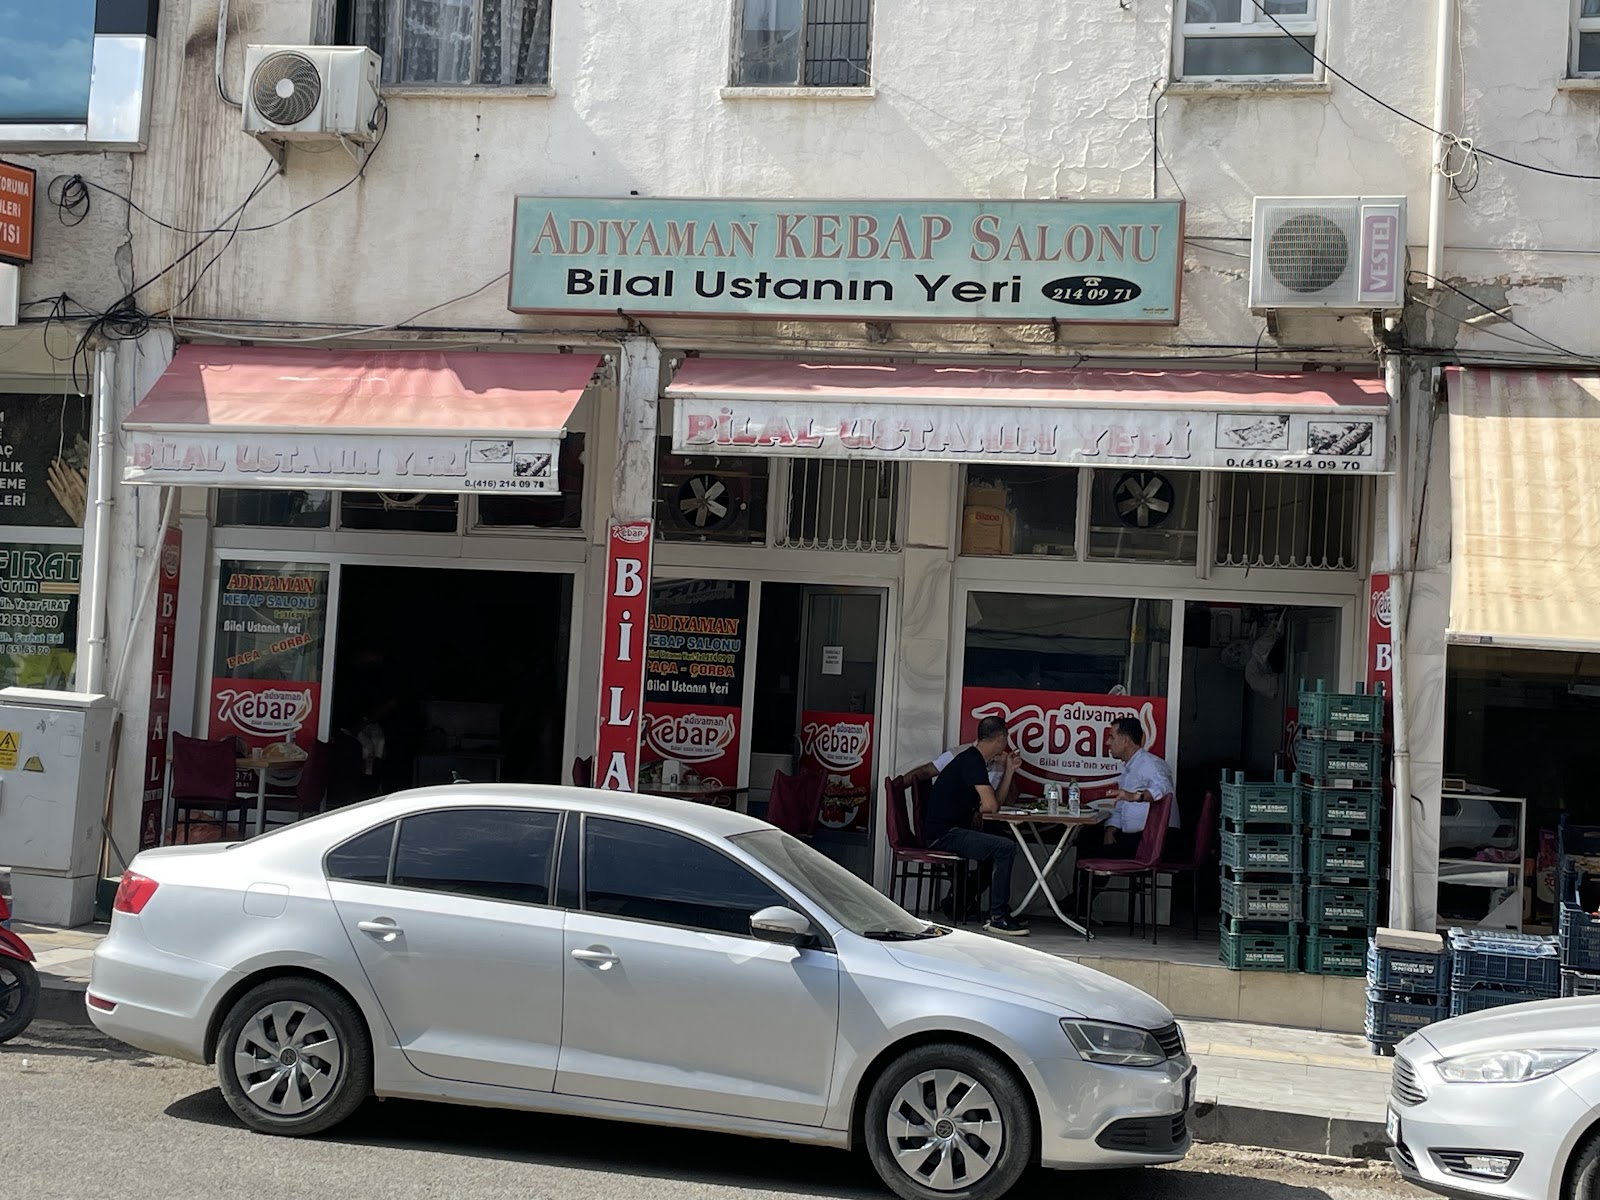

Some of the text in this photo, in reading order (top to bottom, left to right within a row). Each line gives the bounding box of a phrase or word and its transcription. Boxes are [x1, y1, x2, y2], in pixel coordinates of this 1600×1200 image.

[530, 211, 1162, 264] ADIYAMAN KEBAP SALONU
[1369, 217, 1391, 291] VESTEL
[566, 268, 1022, 303] Bilal Ustanın Yeri
[1052, 288, 1133, 301] 214 09 71
[686, 407, 824, 449] BİLAL
[1079, 418, 1192, 460] YERİ
[133, 437, 226, 472] BİLAL
[1226, 457, 1361, 471] 0.(416) 214 09 70
[499, 480, 517, 488] 214
[519, 480, 531, 489] 09
[0, 578, 39, 594] arım
[226, 573, 316, 594] ADIYAMAN
[41, 599, 71, 612] FIRAT
[223, 593, 318, 610] KEBAP SALONU
[31, 614, 44, 627] 35
[44, 615, 58, 628] 20
[224, 619, 245, 632] Bilal
[282, 622, 302, 634] Yeri
[687, 636, 742, 652] SALONU
[647, 679, 669, 692] Bilal
[709, 682, 730, 695] Yeri
[216, 689, 298, 725] Kebap
[804, 722, 859, 755] Kebap
[1039, 757, 1059, 768] Bilal
[1100, 762, 1118, 772] yeri
